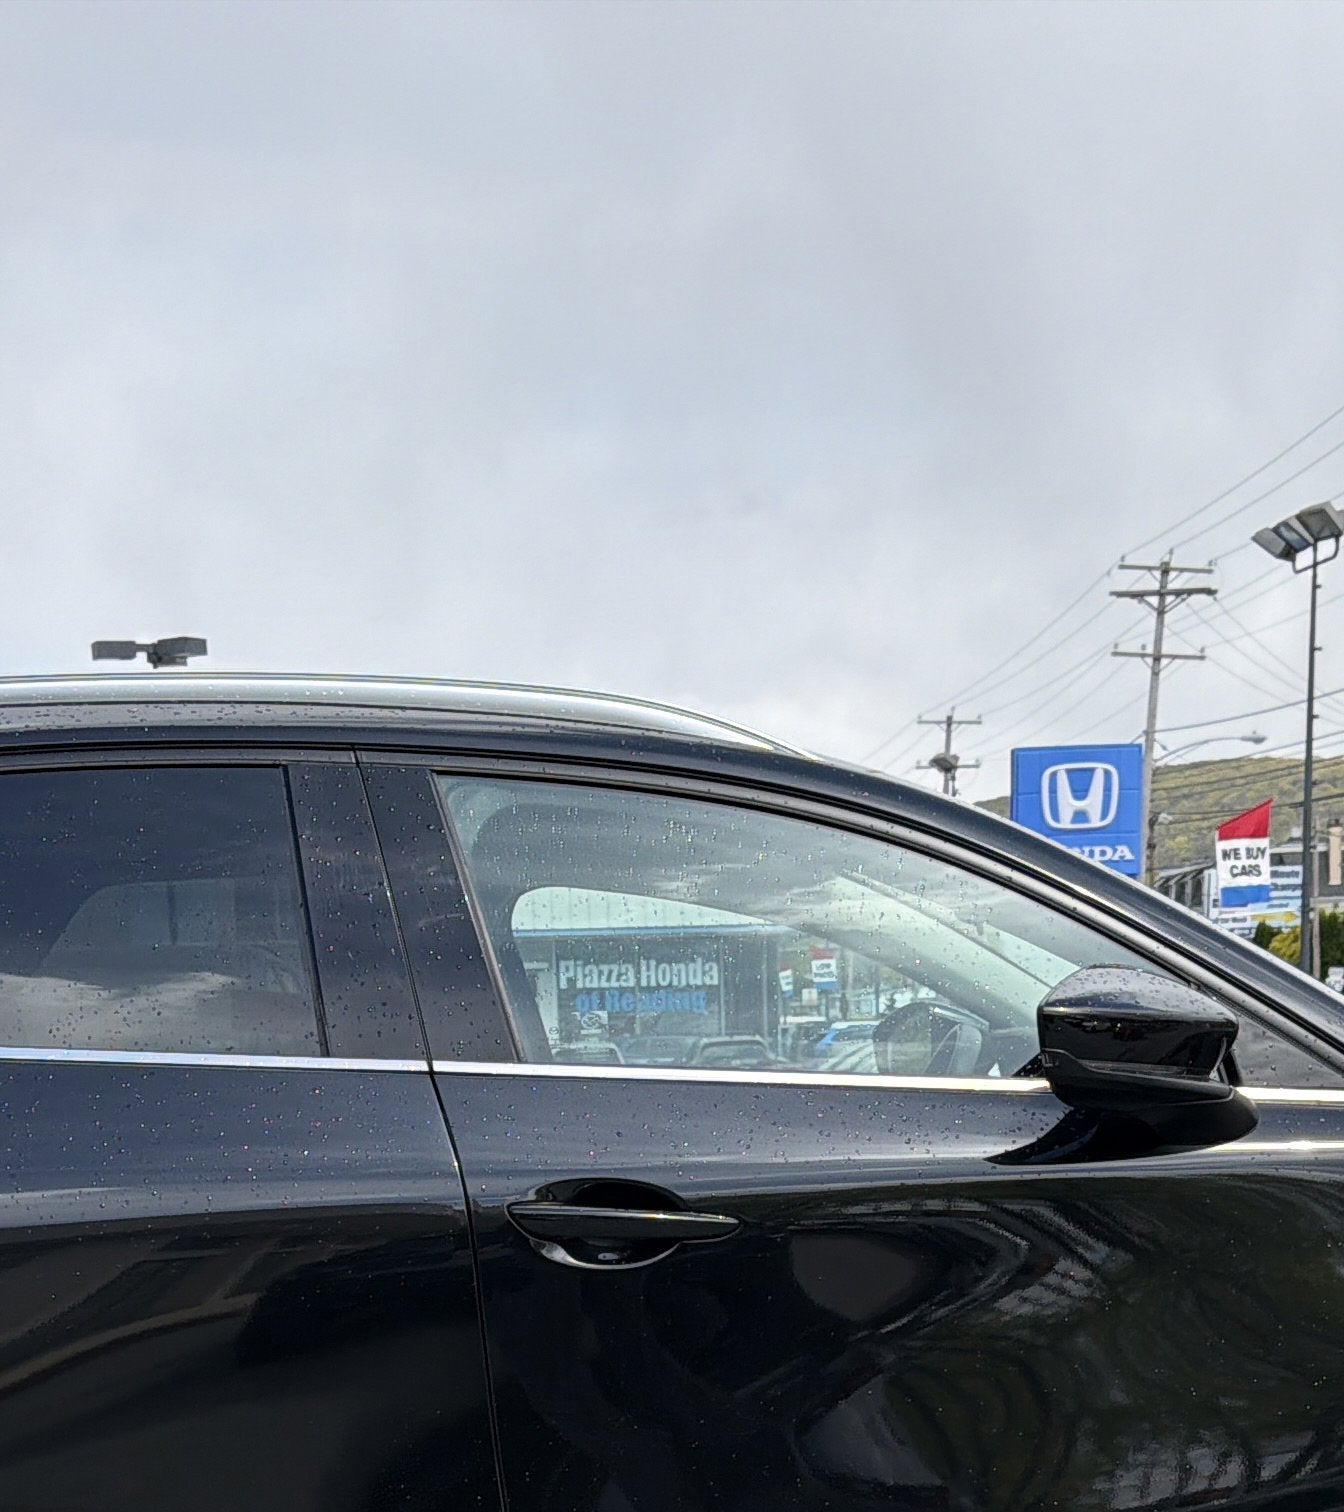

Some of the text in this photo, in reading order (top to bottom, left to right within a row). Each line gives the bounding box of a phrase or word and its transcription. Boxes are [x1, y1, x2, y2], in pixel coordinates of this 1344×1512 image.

[1221, 846, 1267, 861] WE BUY
[1229, 864, 1262, 878] CARS
[558, 957, 720, 989] Piazza Honda
